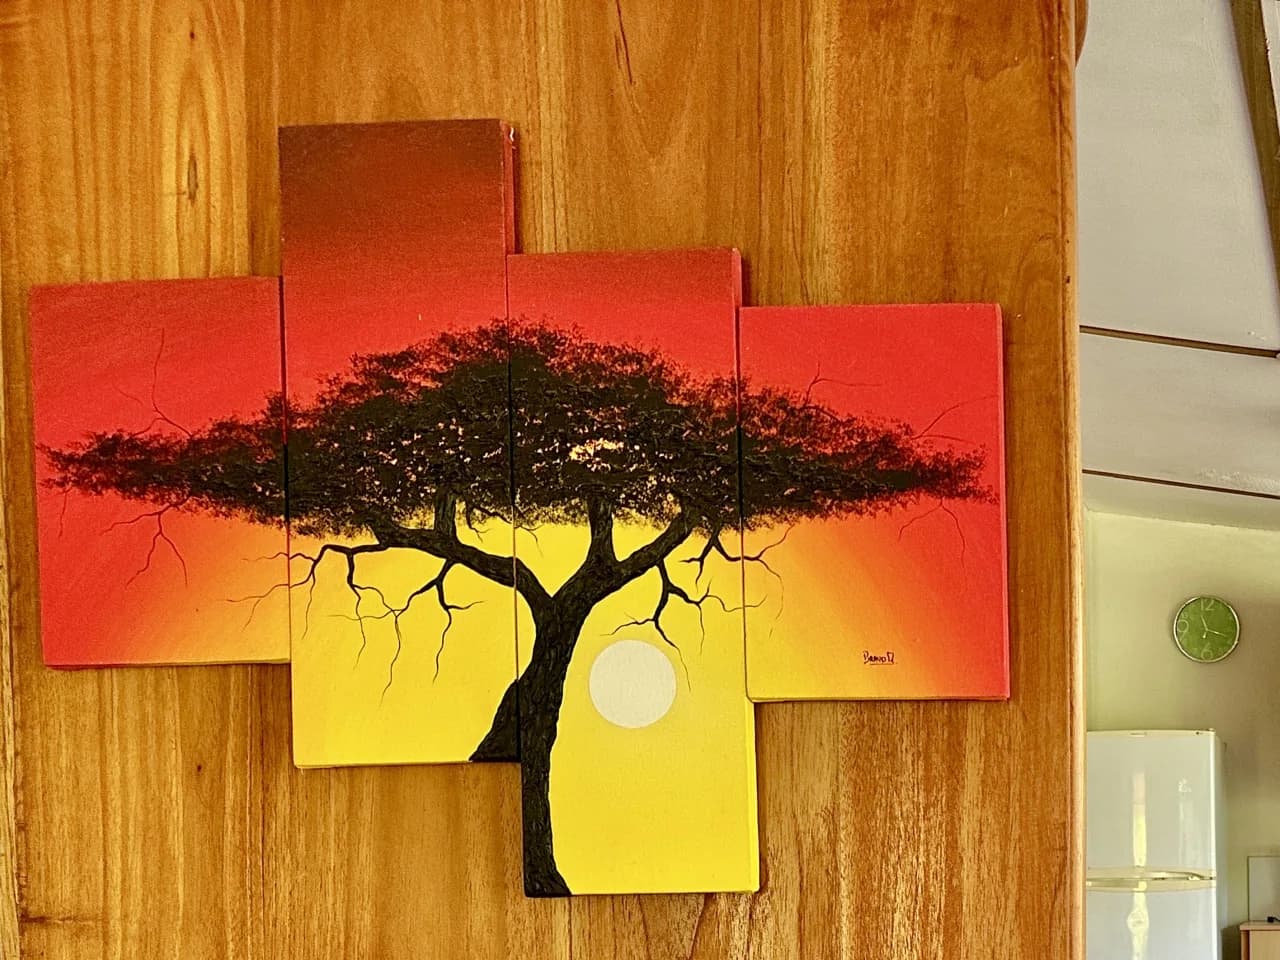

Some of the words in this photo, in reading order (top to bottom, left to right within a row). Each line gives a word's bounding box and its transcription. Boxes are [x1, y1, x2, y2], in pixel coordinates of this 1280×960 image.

[1200, 598, 1215, 612] 12
[1177, 619, 1189, 642] 9
[1200, 642, 1214, 660] 6
